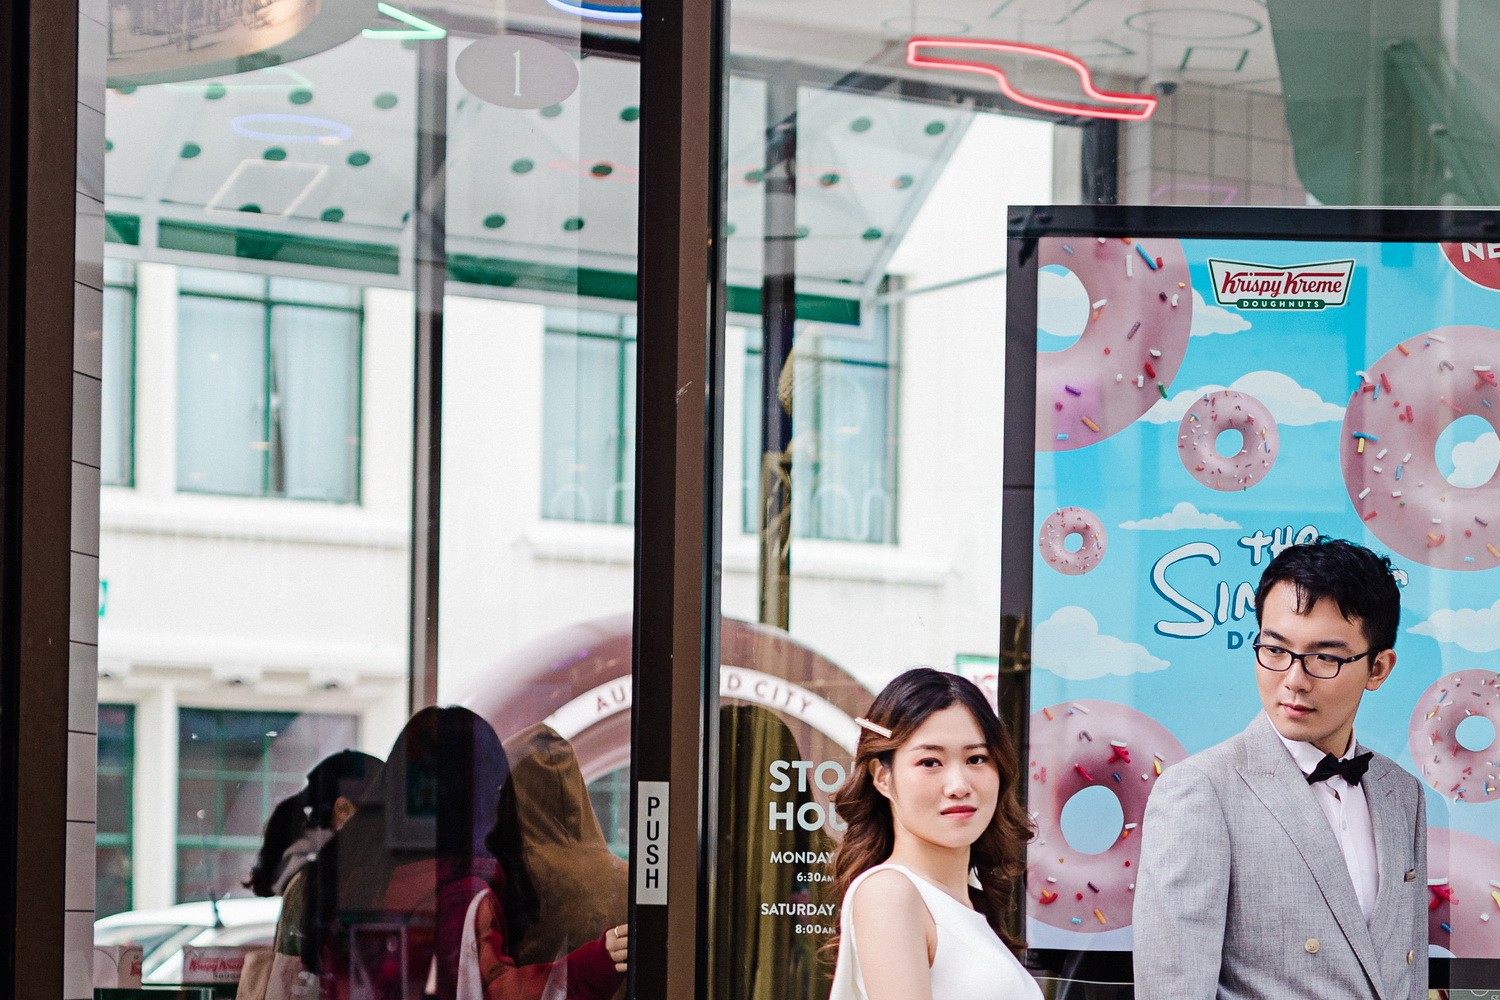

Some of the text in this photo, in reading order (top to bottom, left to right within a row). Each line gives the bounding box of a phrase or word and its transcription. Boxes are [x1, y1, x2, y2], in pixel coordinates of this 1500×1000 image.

[1221, 271, 1346, 298] Krispy Kreme
[754, 680, 813, 715] CITY
[769, 760, 854, 793] STO
[646, 796, 660, 889] PUSH
[770, 852, 834, 864] MONDAY
[761, 903, 835, 916] SATURDAY
